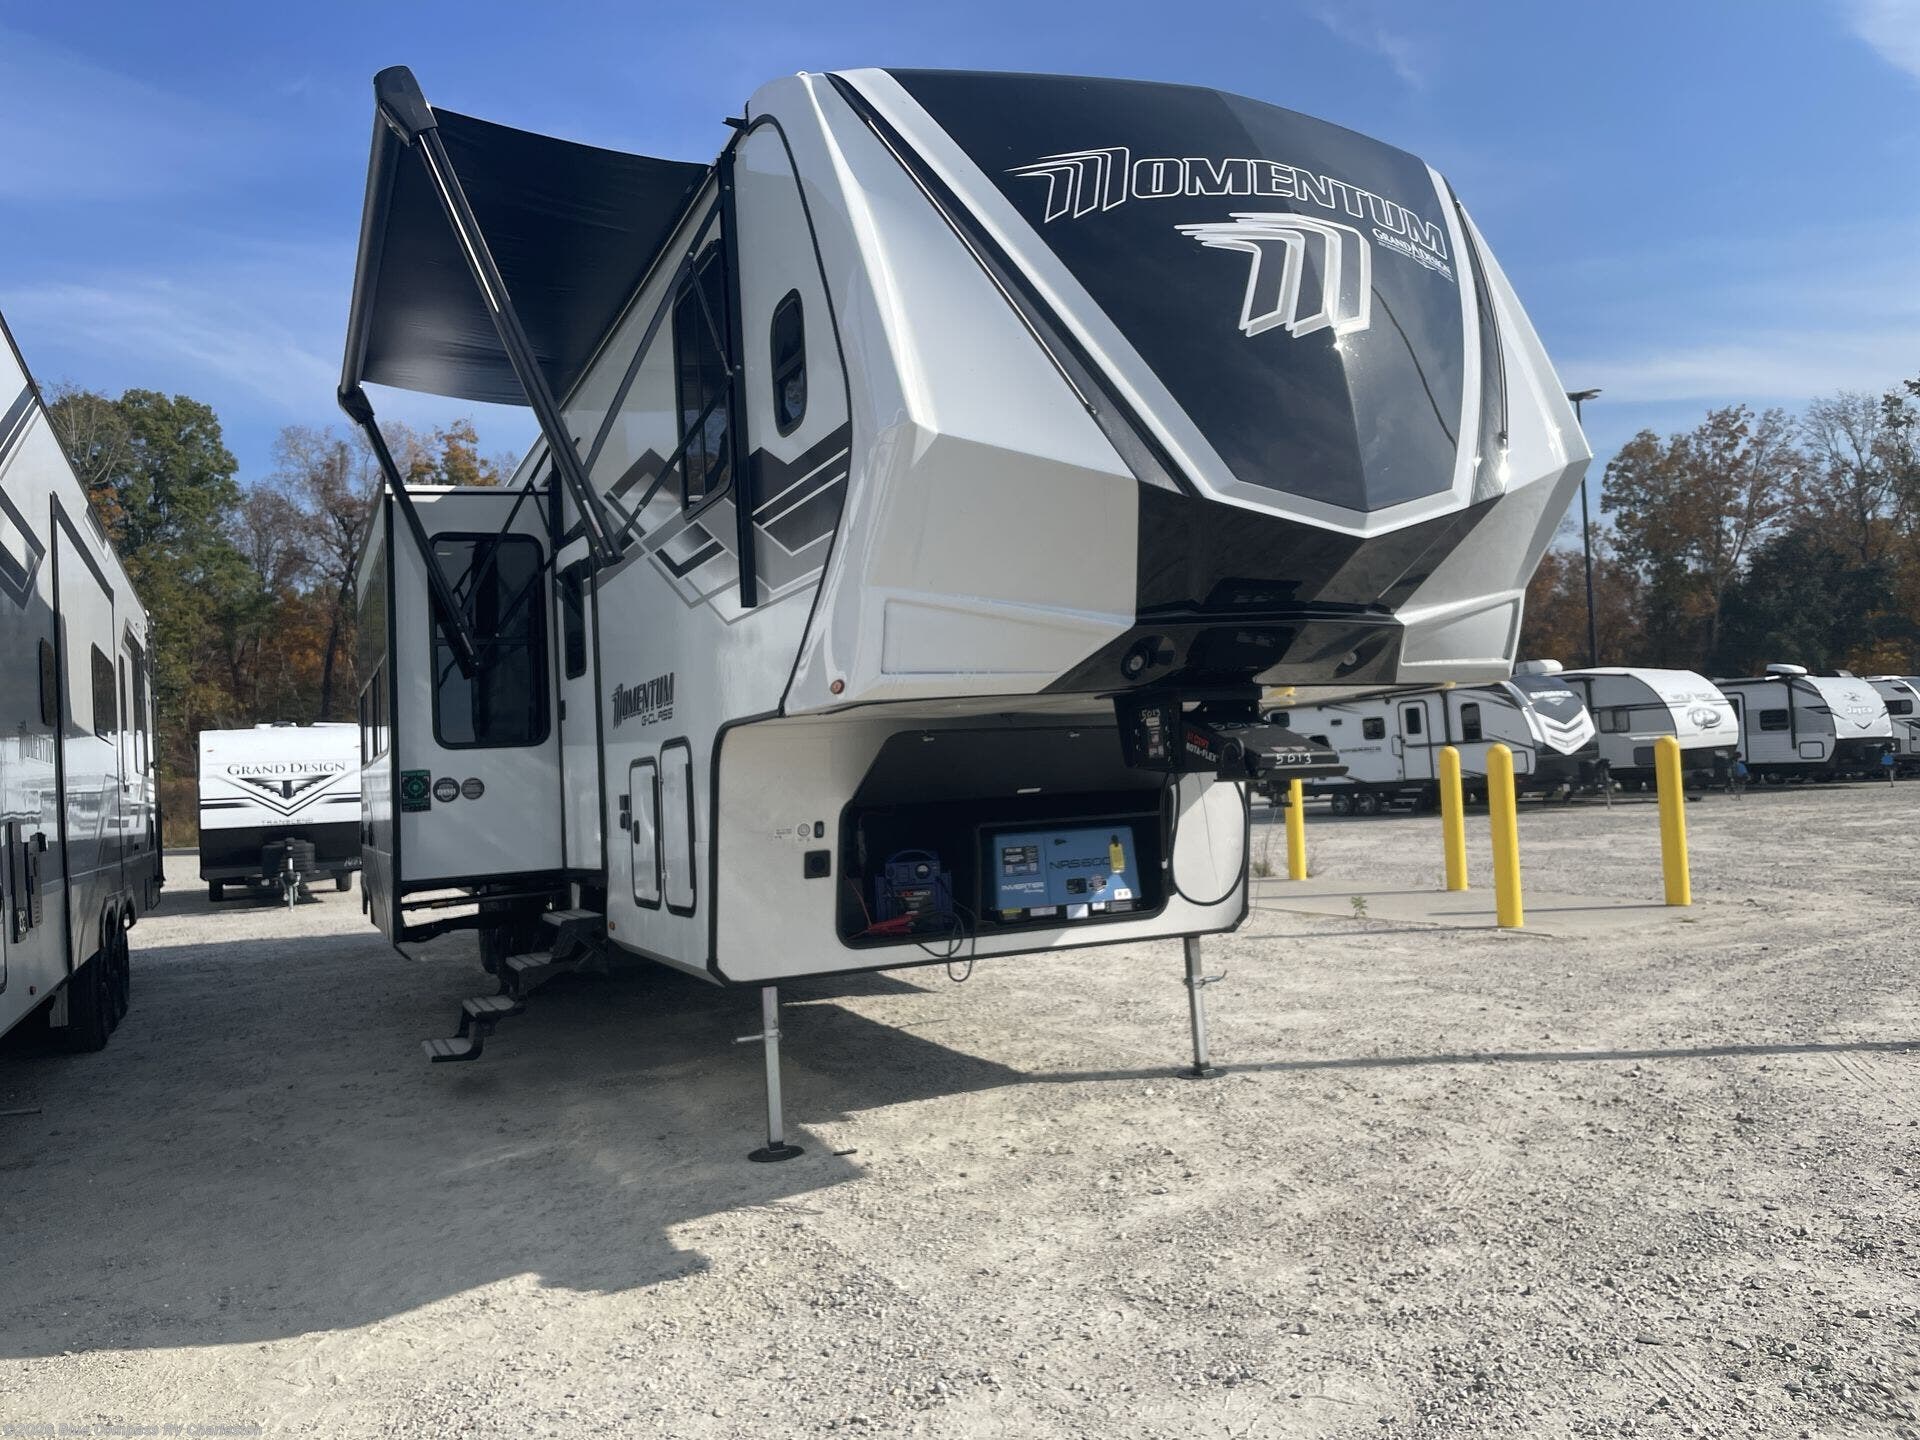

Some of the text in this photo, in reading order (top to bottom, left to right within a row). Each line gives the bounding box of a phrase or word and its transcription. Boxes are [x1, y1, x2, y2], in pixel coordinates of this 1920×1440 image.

[1004, 146, 1449, 260] MOMENTUM
[611, 672, 675, 730] MOMENTUM
[1186, 743, 1217, 762] ROTA-FLEX
[1275, 753, 1312, 765] 5013
[227, 761, 346, 775] GRAND DESIGN
